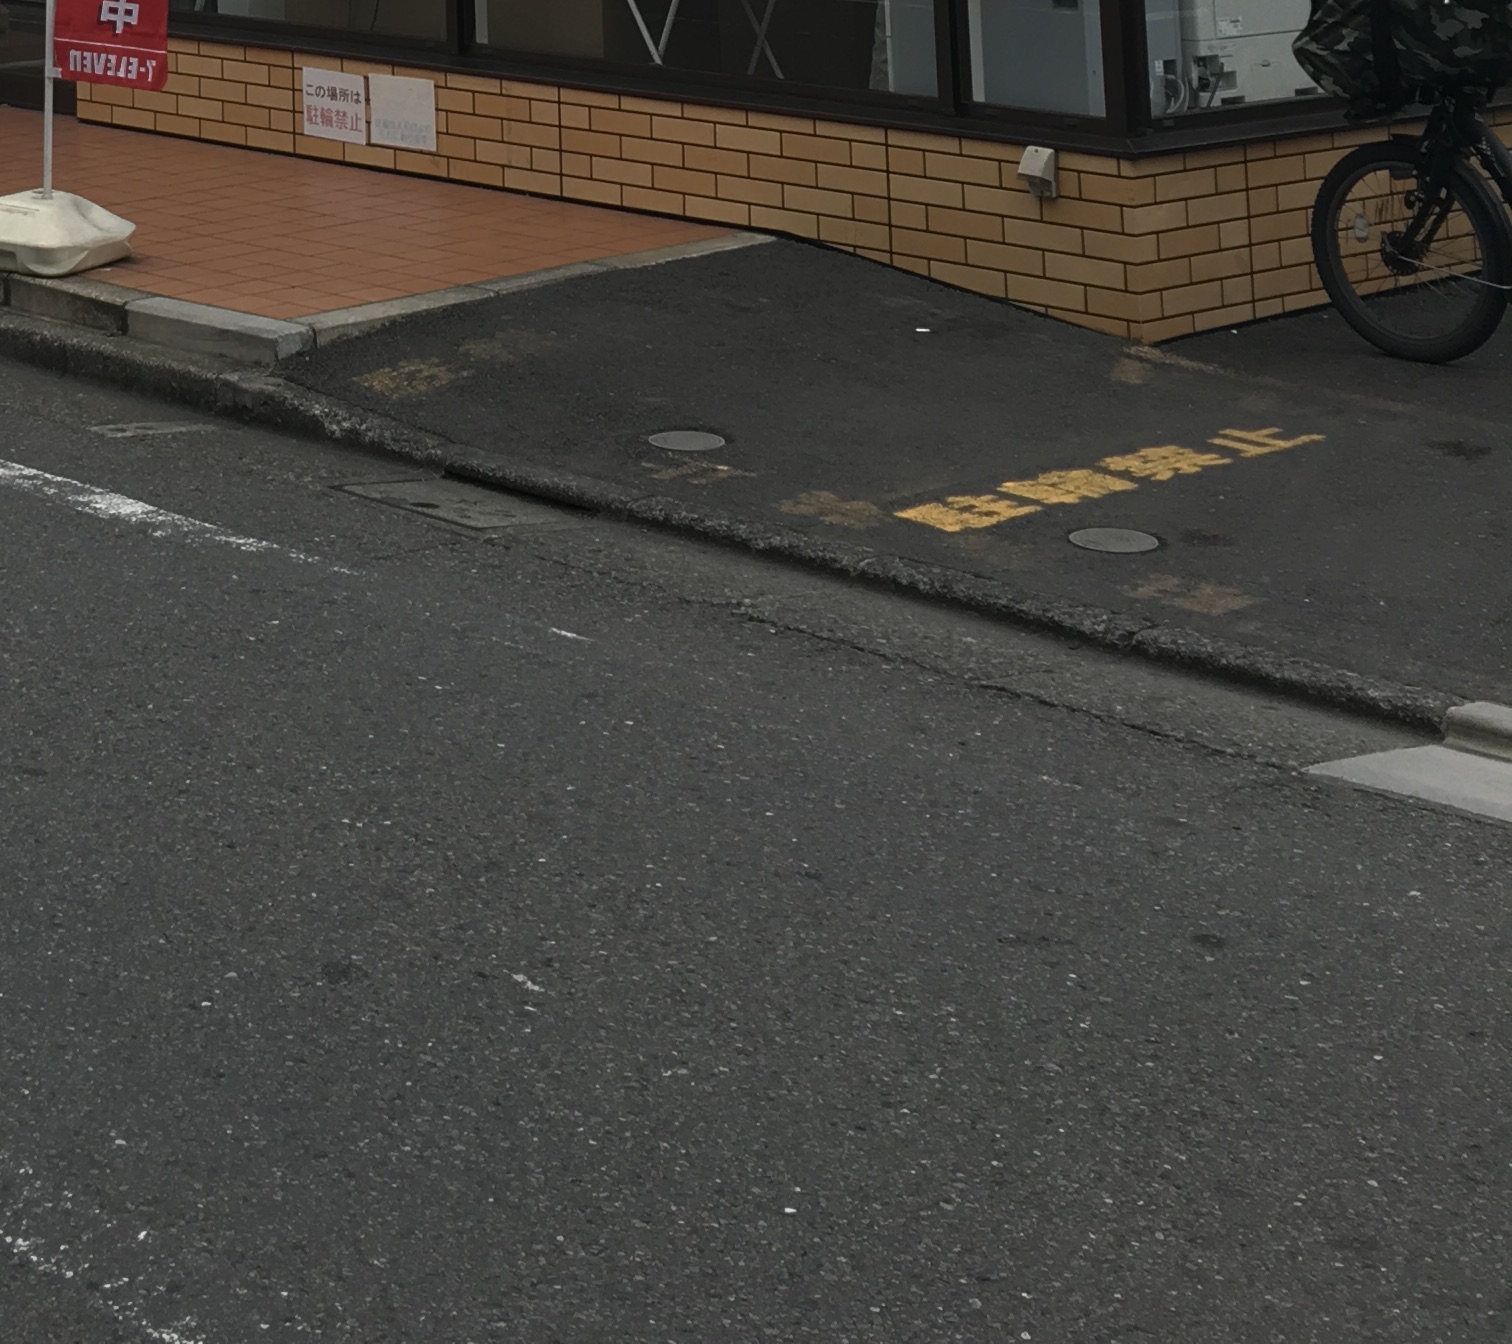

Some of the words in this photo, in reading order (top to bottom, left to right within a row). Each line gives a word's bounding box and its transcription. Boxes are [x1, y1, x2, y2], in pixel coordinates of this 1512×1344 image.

[305, 84, 362, 104] この場所は
[306, 104, 363, 133] 駐輪禁止
